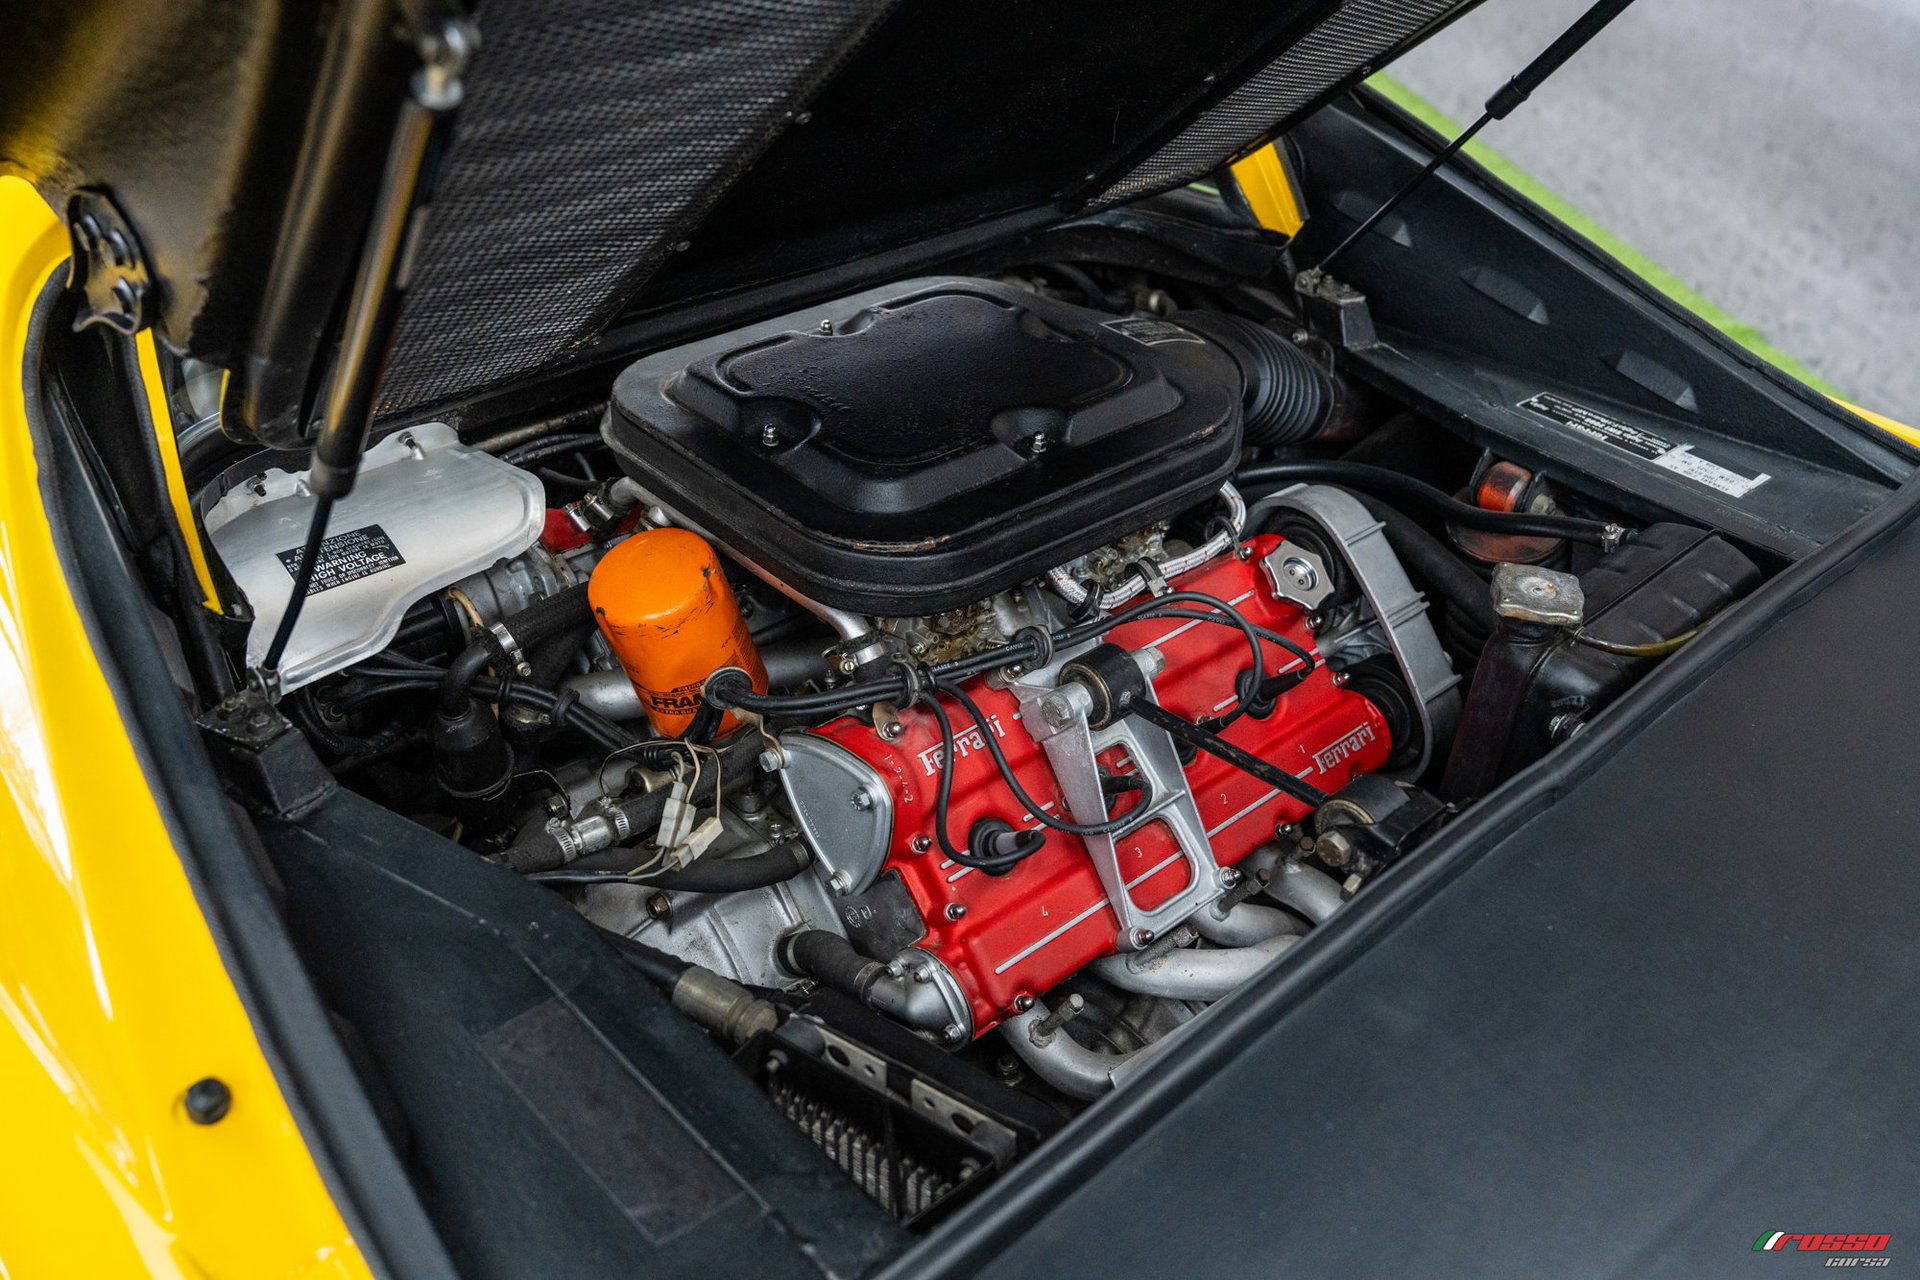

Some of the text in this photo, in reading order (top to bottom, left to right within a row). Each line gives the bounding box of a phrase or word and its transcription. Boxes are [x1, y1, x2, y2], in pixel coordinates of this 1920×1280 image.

[313, 551, 366, 571] WARNING
[338, 552, 386, 571] VOLTAGE
[916, 714, 1007, 777] Ferai
[1312, 721, 1376, 775] Ferrari
[1220, 793, 1229, 805] 2
[1133, 846, 1143, 858] 3
